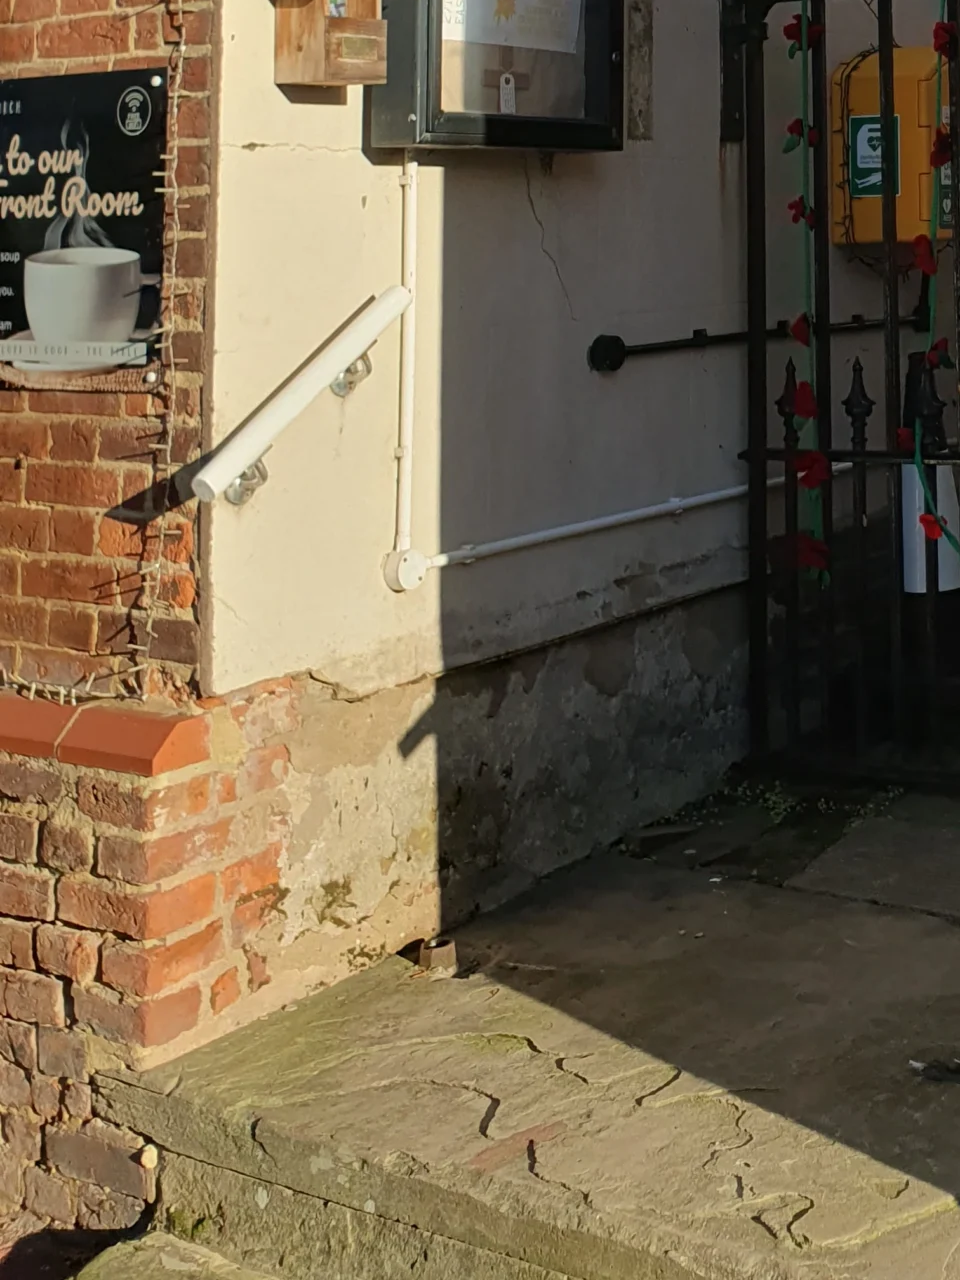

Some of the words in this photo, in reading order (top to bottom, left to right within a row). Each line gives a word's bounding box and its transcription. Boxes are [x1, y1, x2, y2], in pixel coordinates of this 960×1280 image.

[6, 134, 35, 175] to
[38, 149, 84, 174] our
[0, 176, 57, 219] ront
[61, 176, 144, 218] Room
[0, 251, 20, 264] soup
